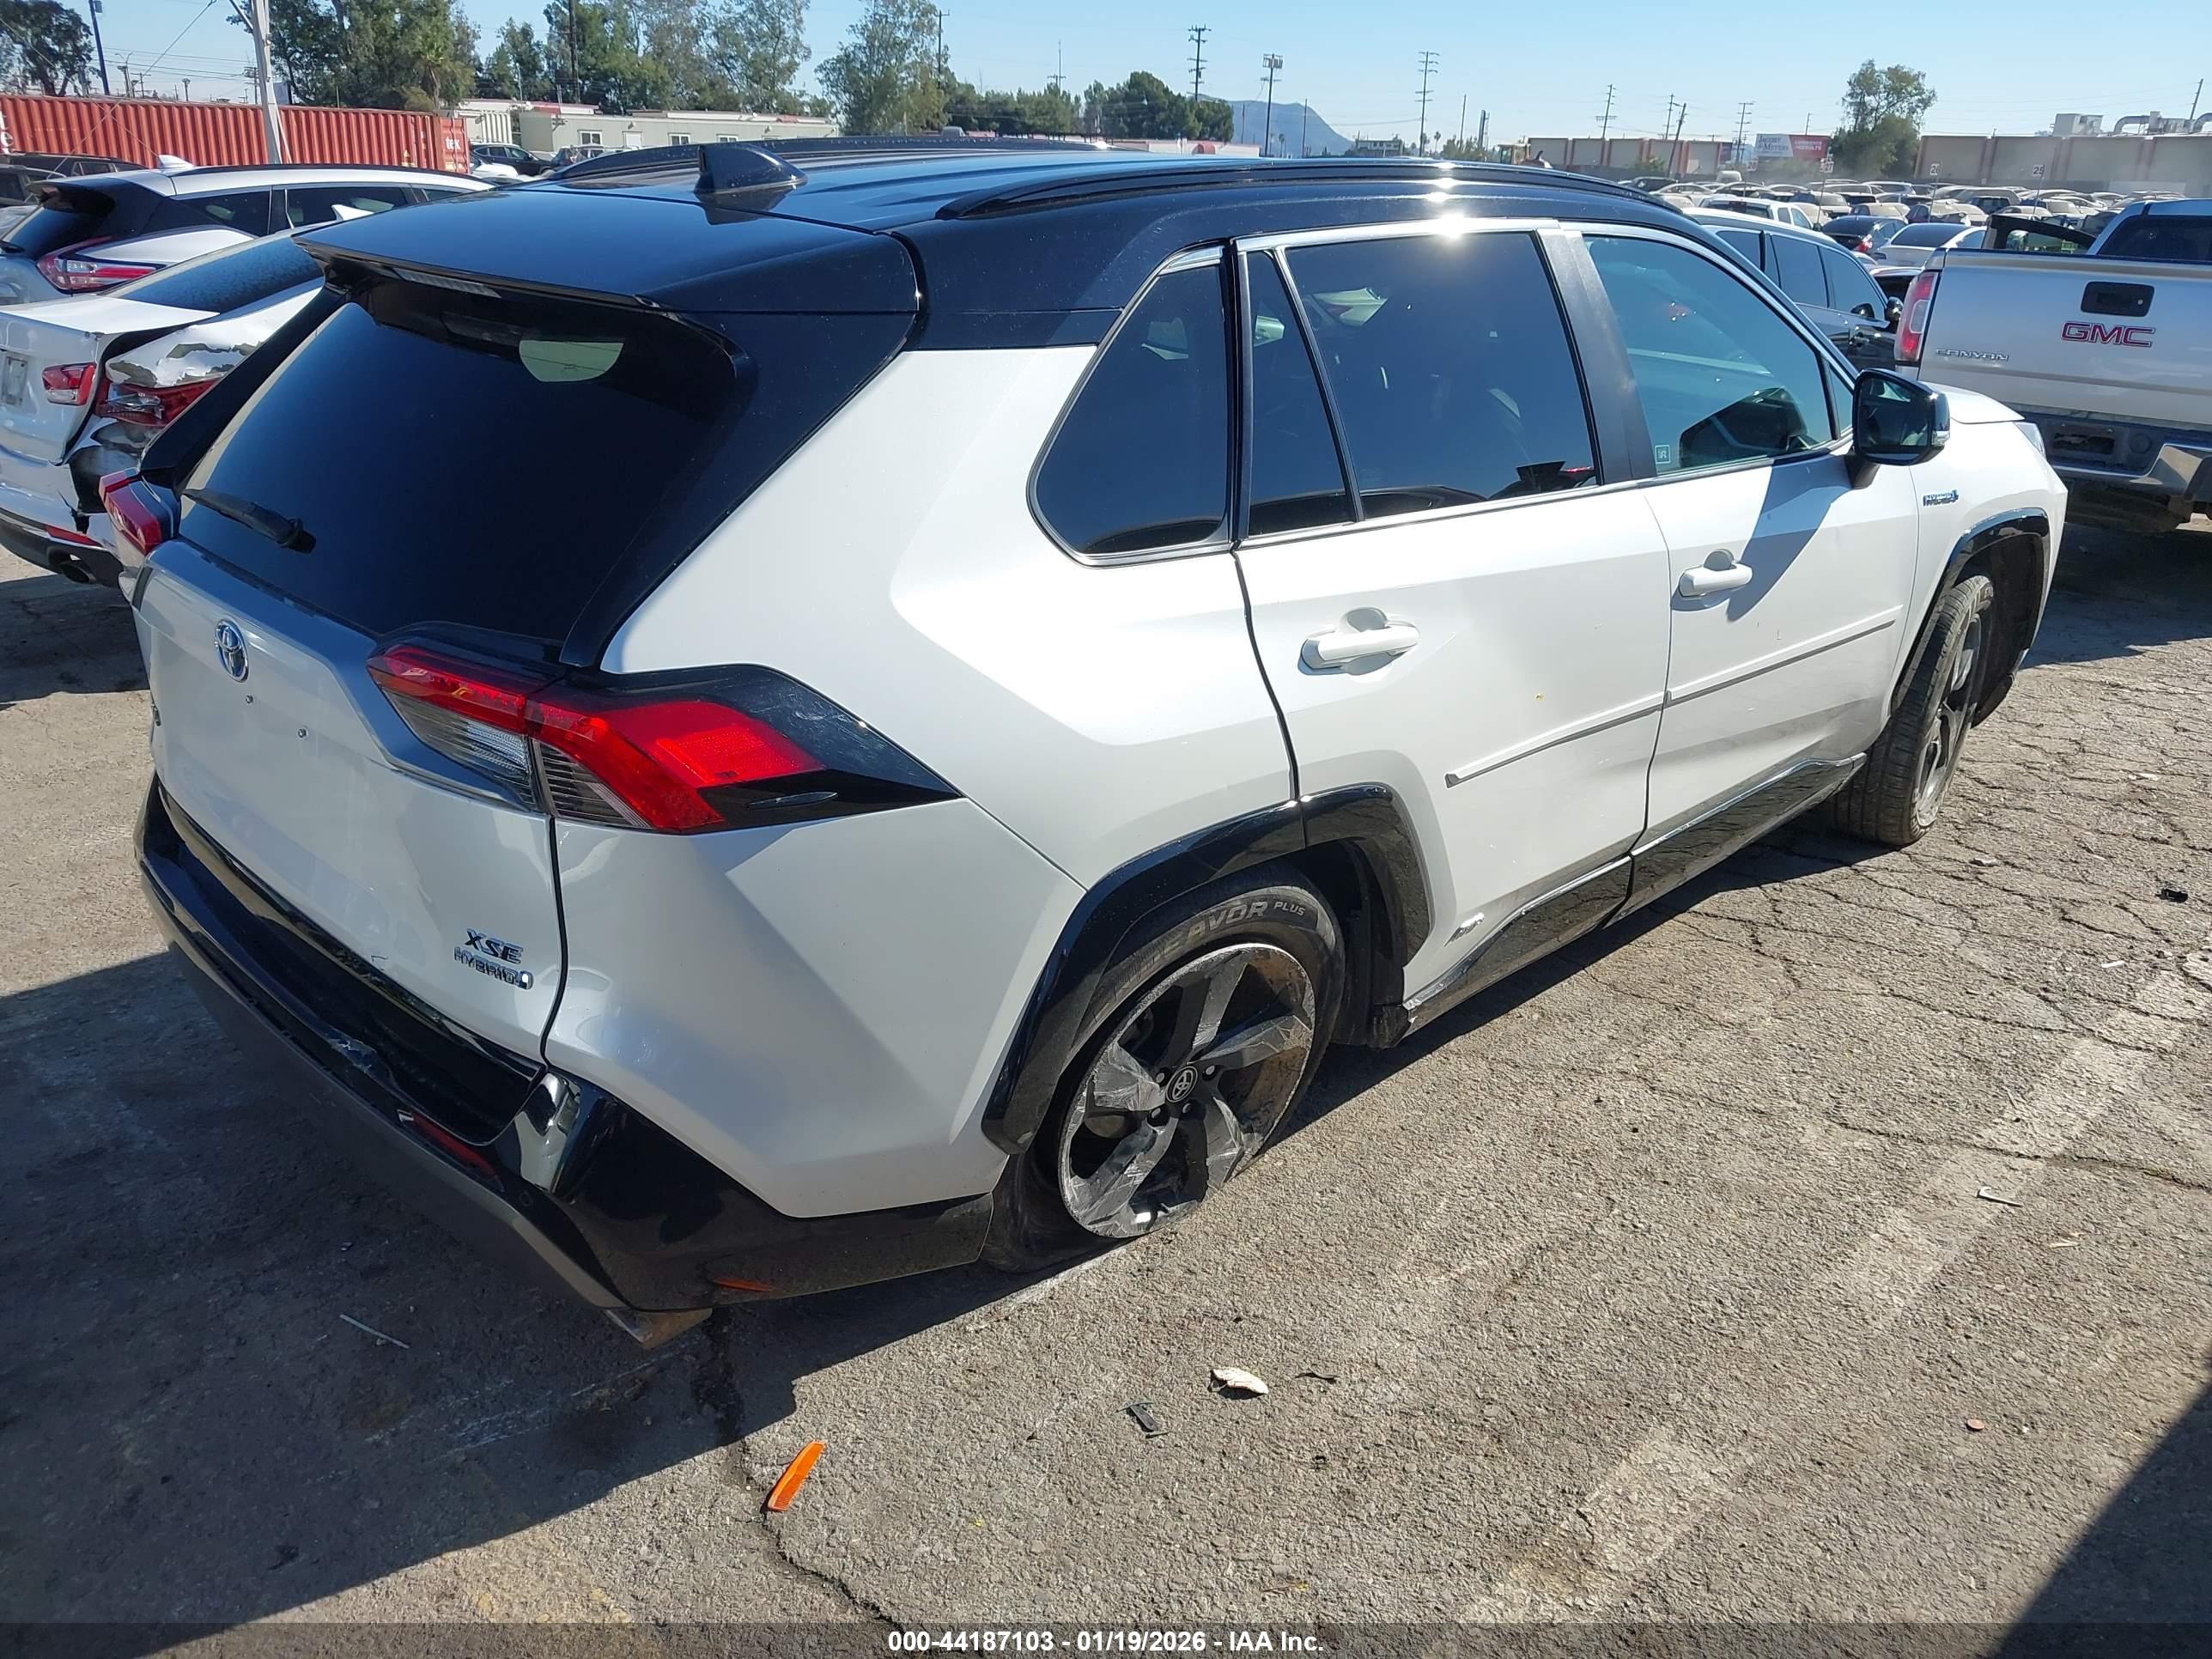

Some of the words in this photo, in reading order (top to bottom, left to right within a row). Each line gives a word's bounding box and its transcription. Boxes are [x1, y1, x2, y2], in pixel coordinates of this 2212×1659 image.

[446, 136, 460, 149] tex
[2061, 321, 2155, 347] GMC
[1936, 349, 2009, 362] CANYON
[1273, 901, 1306, 916] PLUS
[465, 927, 523, 965] XSE
[453, 946, 519, 985] HYBRID
